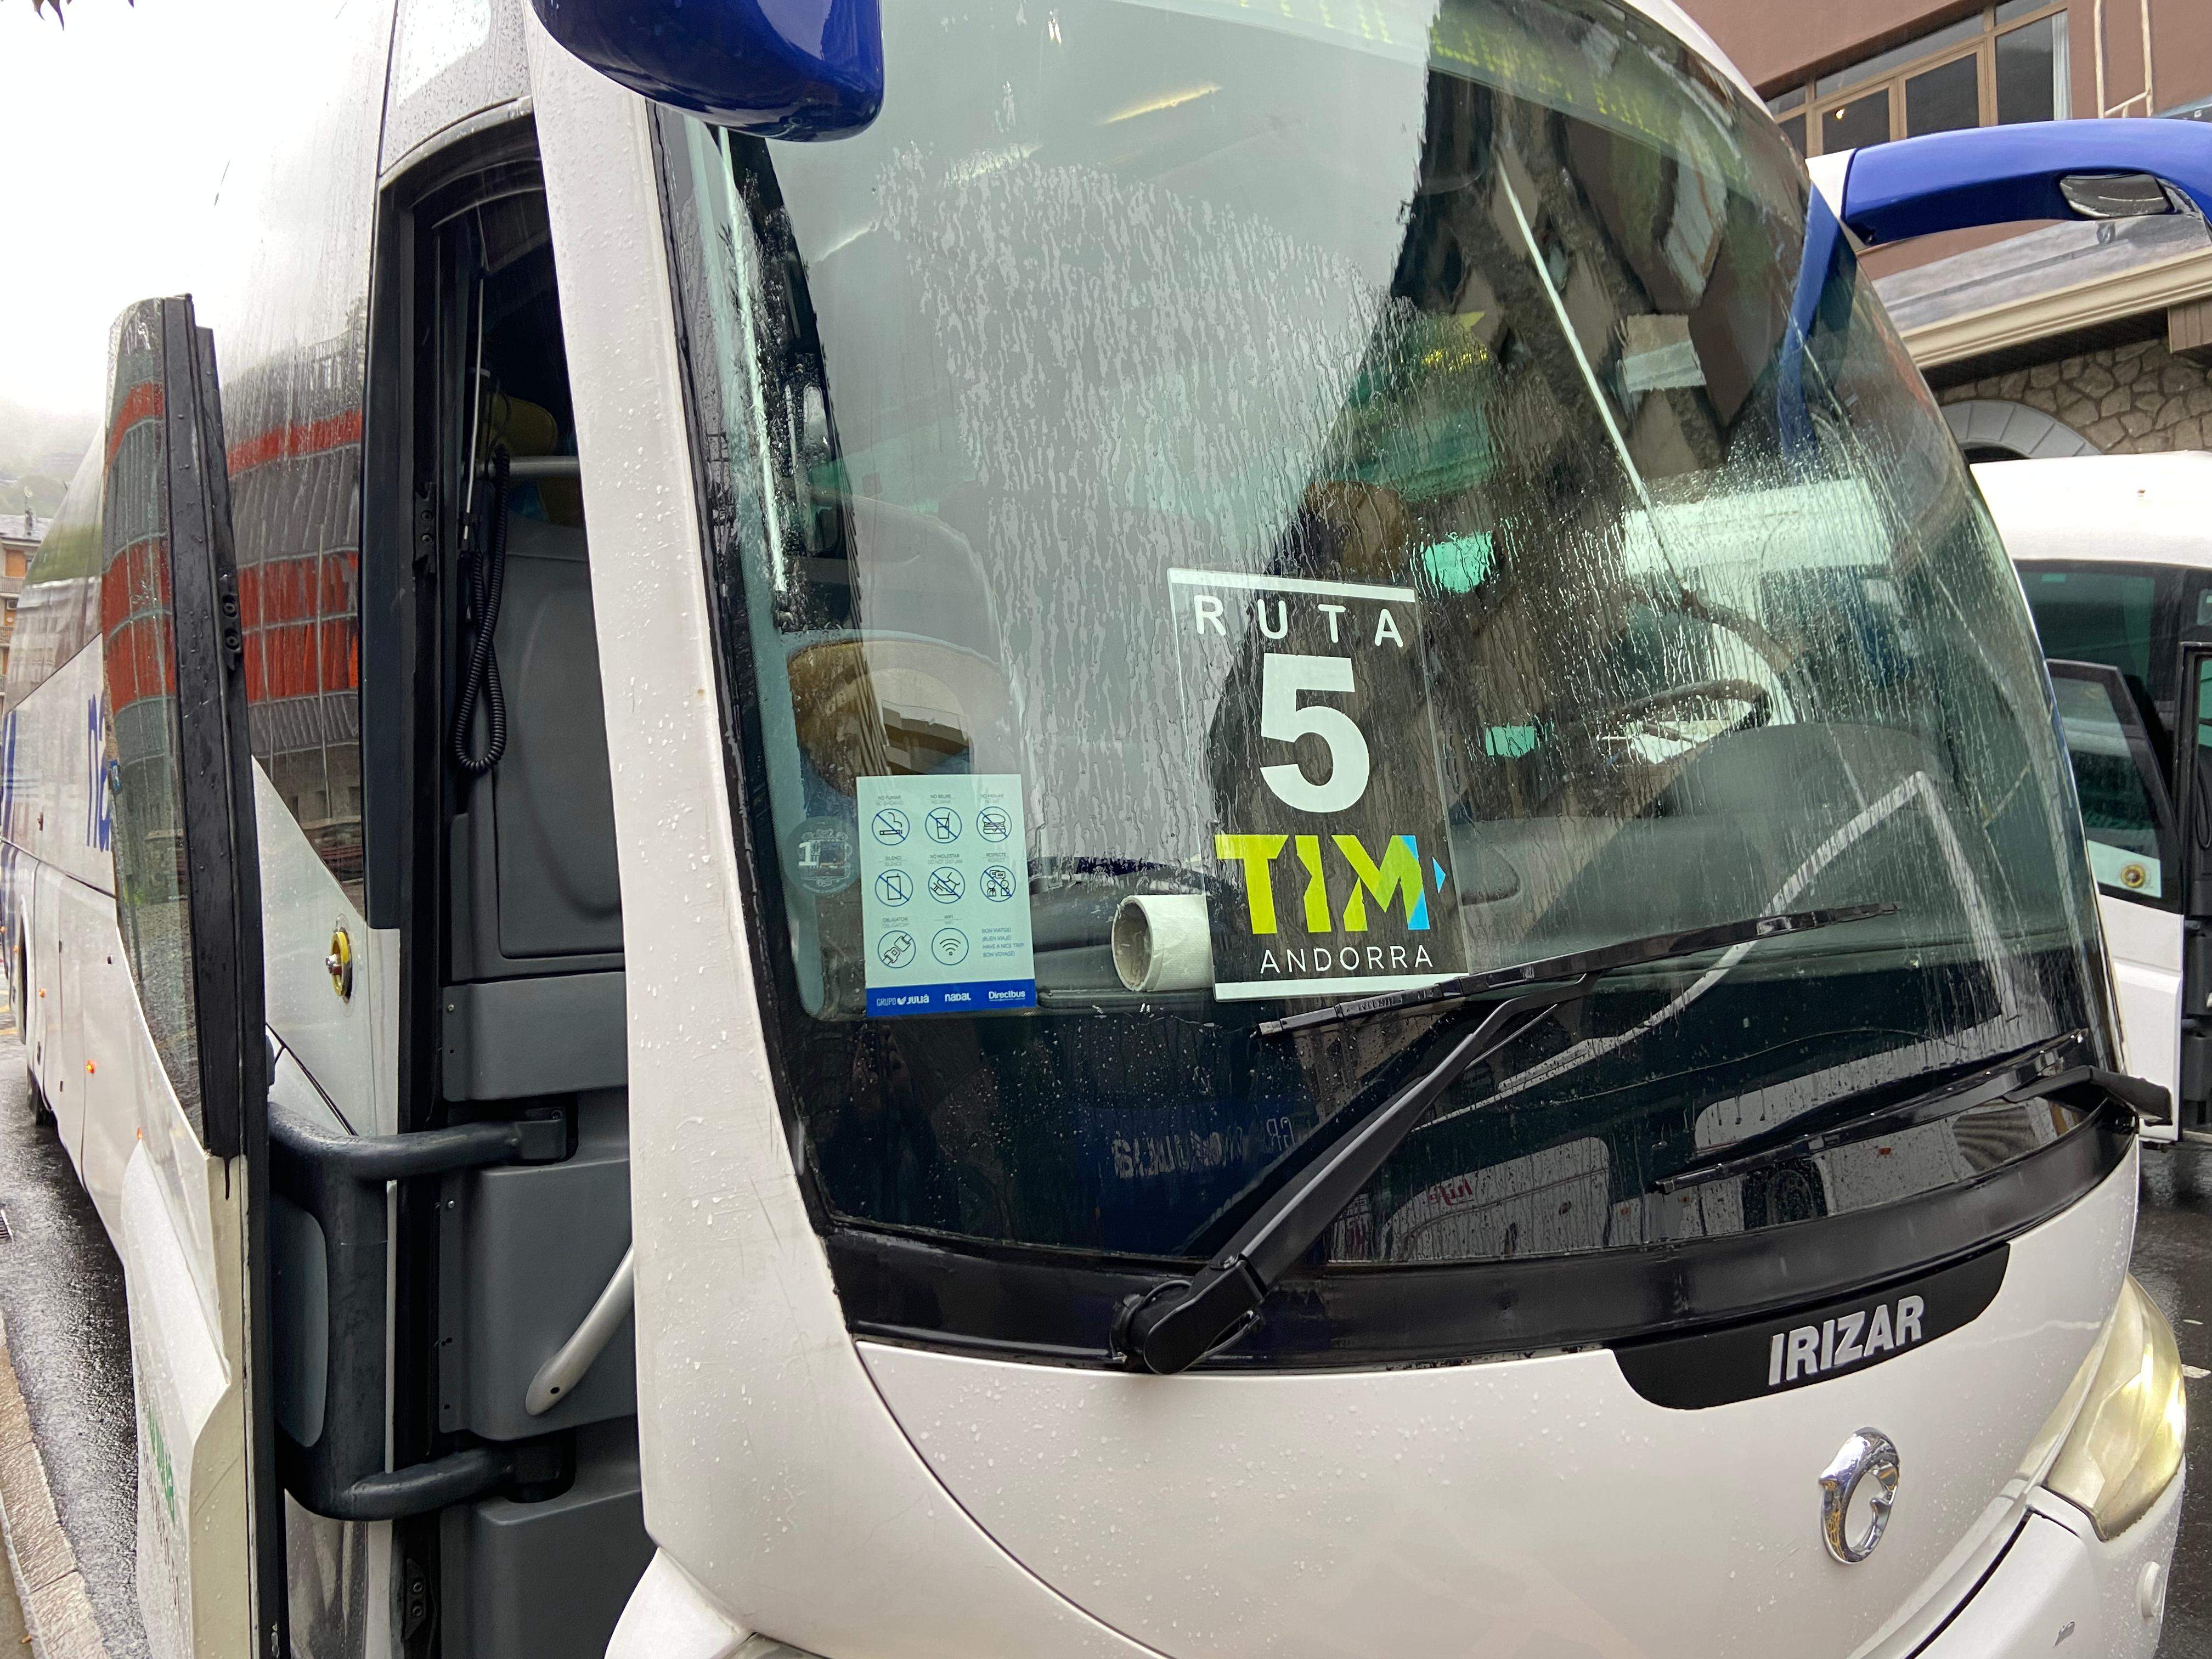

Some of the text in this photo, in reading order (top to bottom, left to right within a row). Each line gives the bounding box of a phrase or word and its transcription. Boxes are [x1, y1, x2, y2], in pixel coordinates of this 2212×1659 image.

[1194, 594, 1403, 648] RUTA
[1260, 653, 1370, 813] 5
[1214, 834, 1430, 934] TIM
[1260, 945, 1434, 975] ANDORRA
[876, 997, 896, 1007] GRUPO
[1769, 1295, 1925, 1386] IRIZAR
